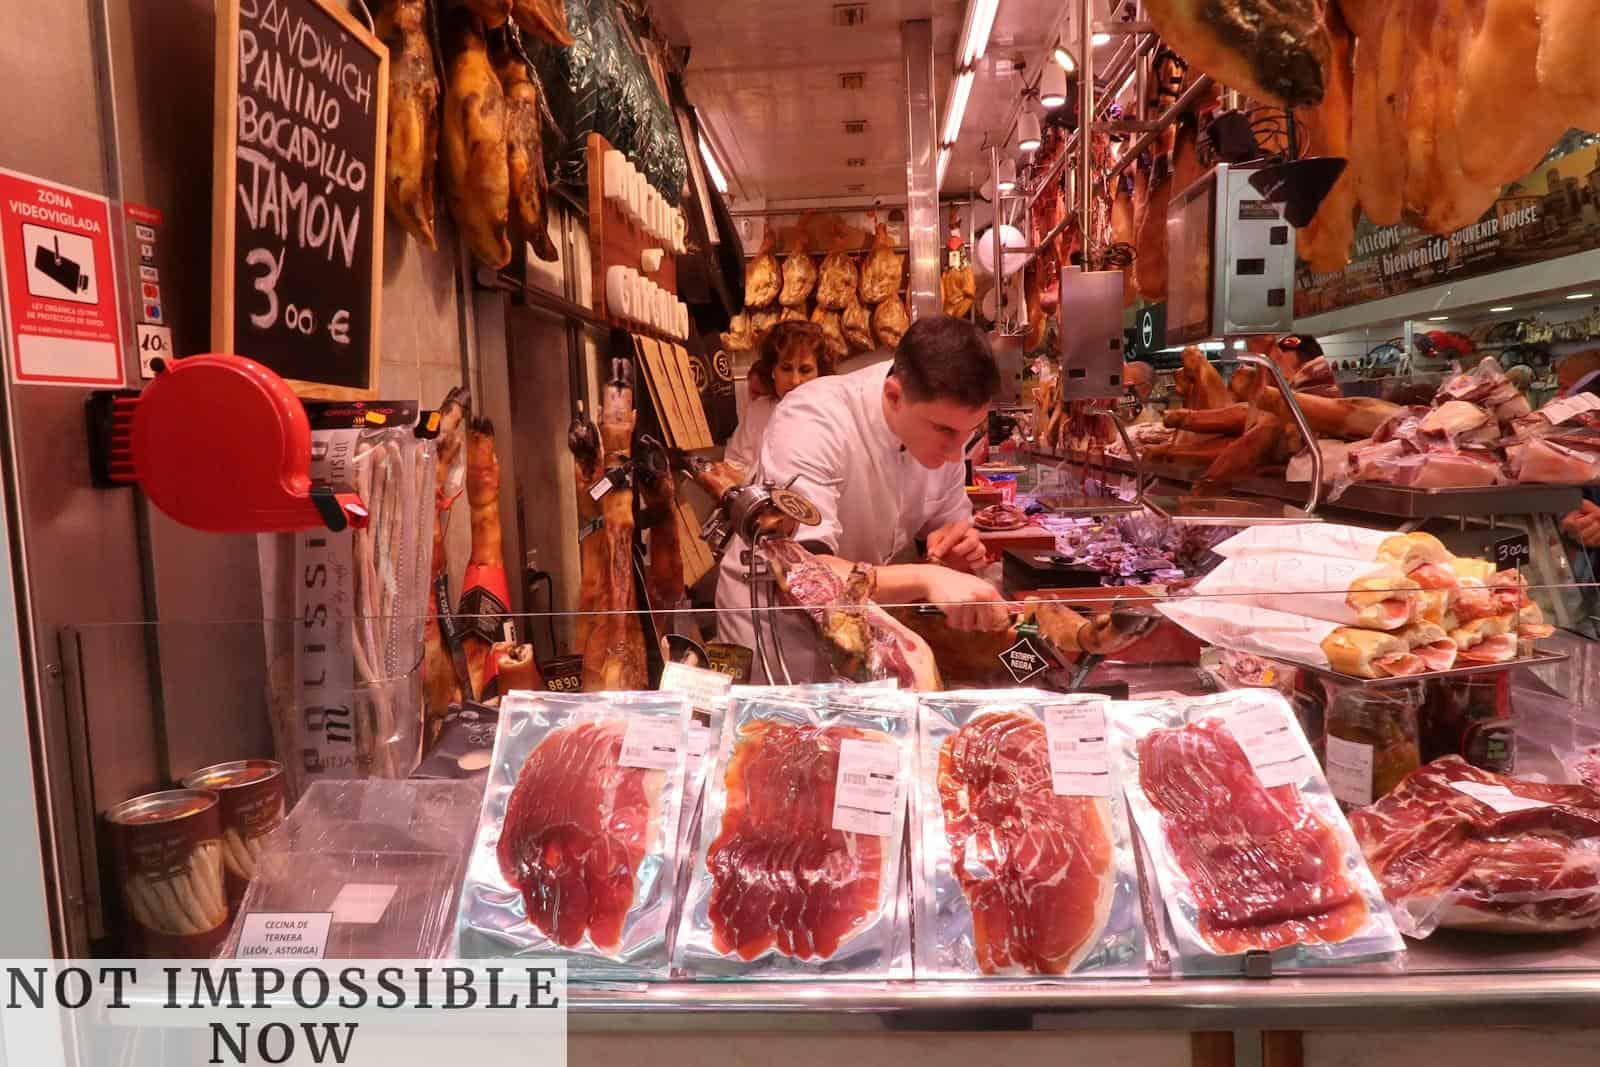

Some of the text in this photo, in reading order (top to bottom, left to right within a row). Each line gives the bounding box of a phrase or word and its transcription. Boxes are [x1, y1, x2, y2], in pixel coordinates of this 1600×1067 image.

[239, 29, 340, 129] PANINO
[238, 95, 366, 192] BOCADILLO
[9, 199, 101, 233] VIDEOVIGILADA
[37, 189, 73, 209] ZONA
[237, 145, 360, 268] JAMÓN
[1451, 206, 1537, 247] SOUVENIR HOUSE
[1383, 237, 1451, 276] bienvenido
[265, 920, 308, 929] CECINA DE
[265, 933, 303, 942] TERNERA
[275, 945, 319, 956] ASTORGA)
